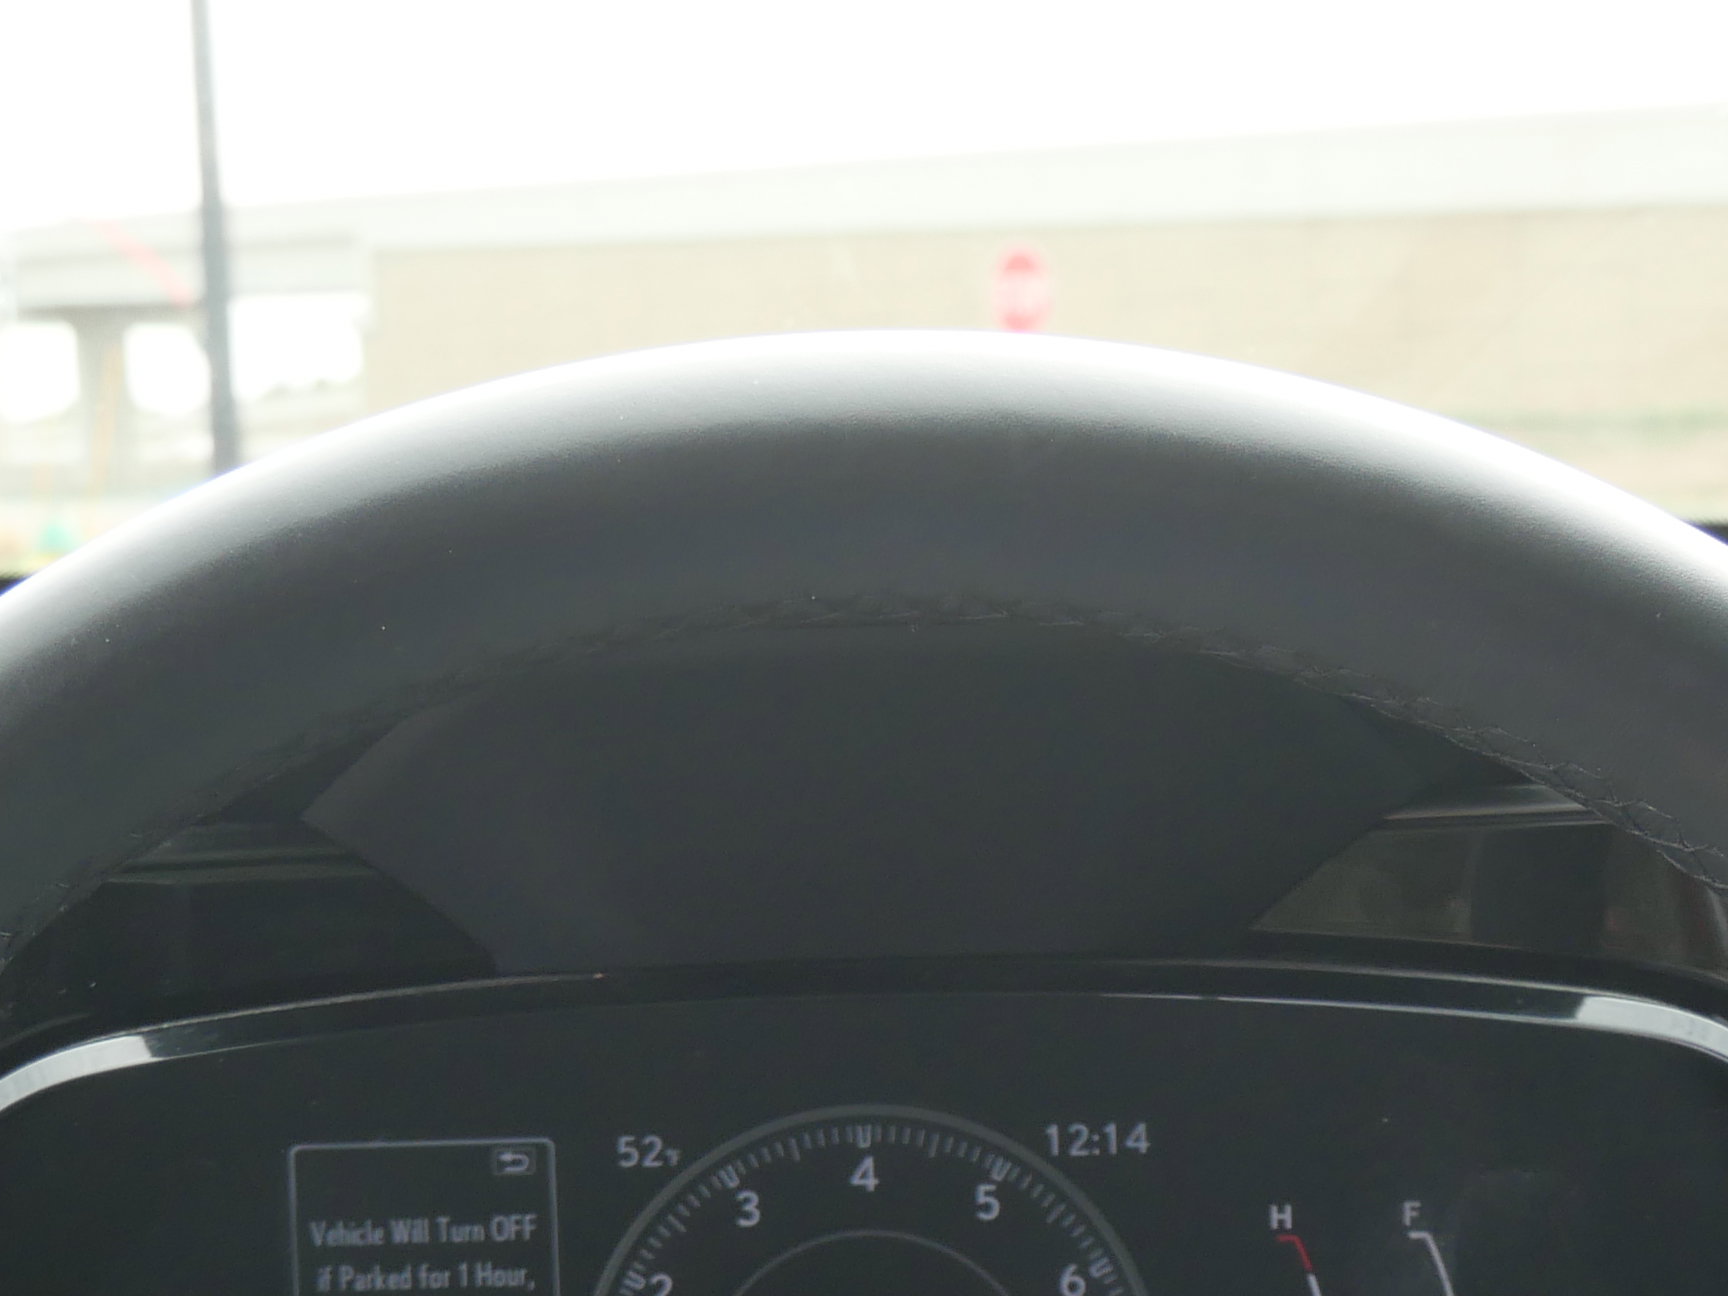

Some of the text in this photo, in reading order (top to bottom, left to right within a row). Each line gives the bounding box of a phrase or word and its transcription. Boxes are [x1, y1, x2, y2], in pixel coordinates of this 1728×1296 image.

[1045, 1123, 1150, 1157] 12:14
[849, 1157, 879, 1192] 4
[737, 1191, 761, 1227] 3
[975, 1185, 1000, 1221] 5
[1269, 1204, 1292, 1229] H
[1402, 1201, 1421, 1226] F
[309, 1213, 537, 1247] Vehicle Will Turn OFF
[338, 1264, 412, 1292] Parked
[418, 1262, 450, 1290] for
[458, 1261, 468, 1288] 1
[475, 1261, 536, 1292] Hour,
